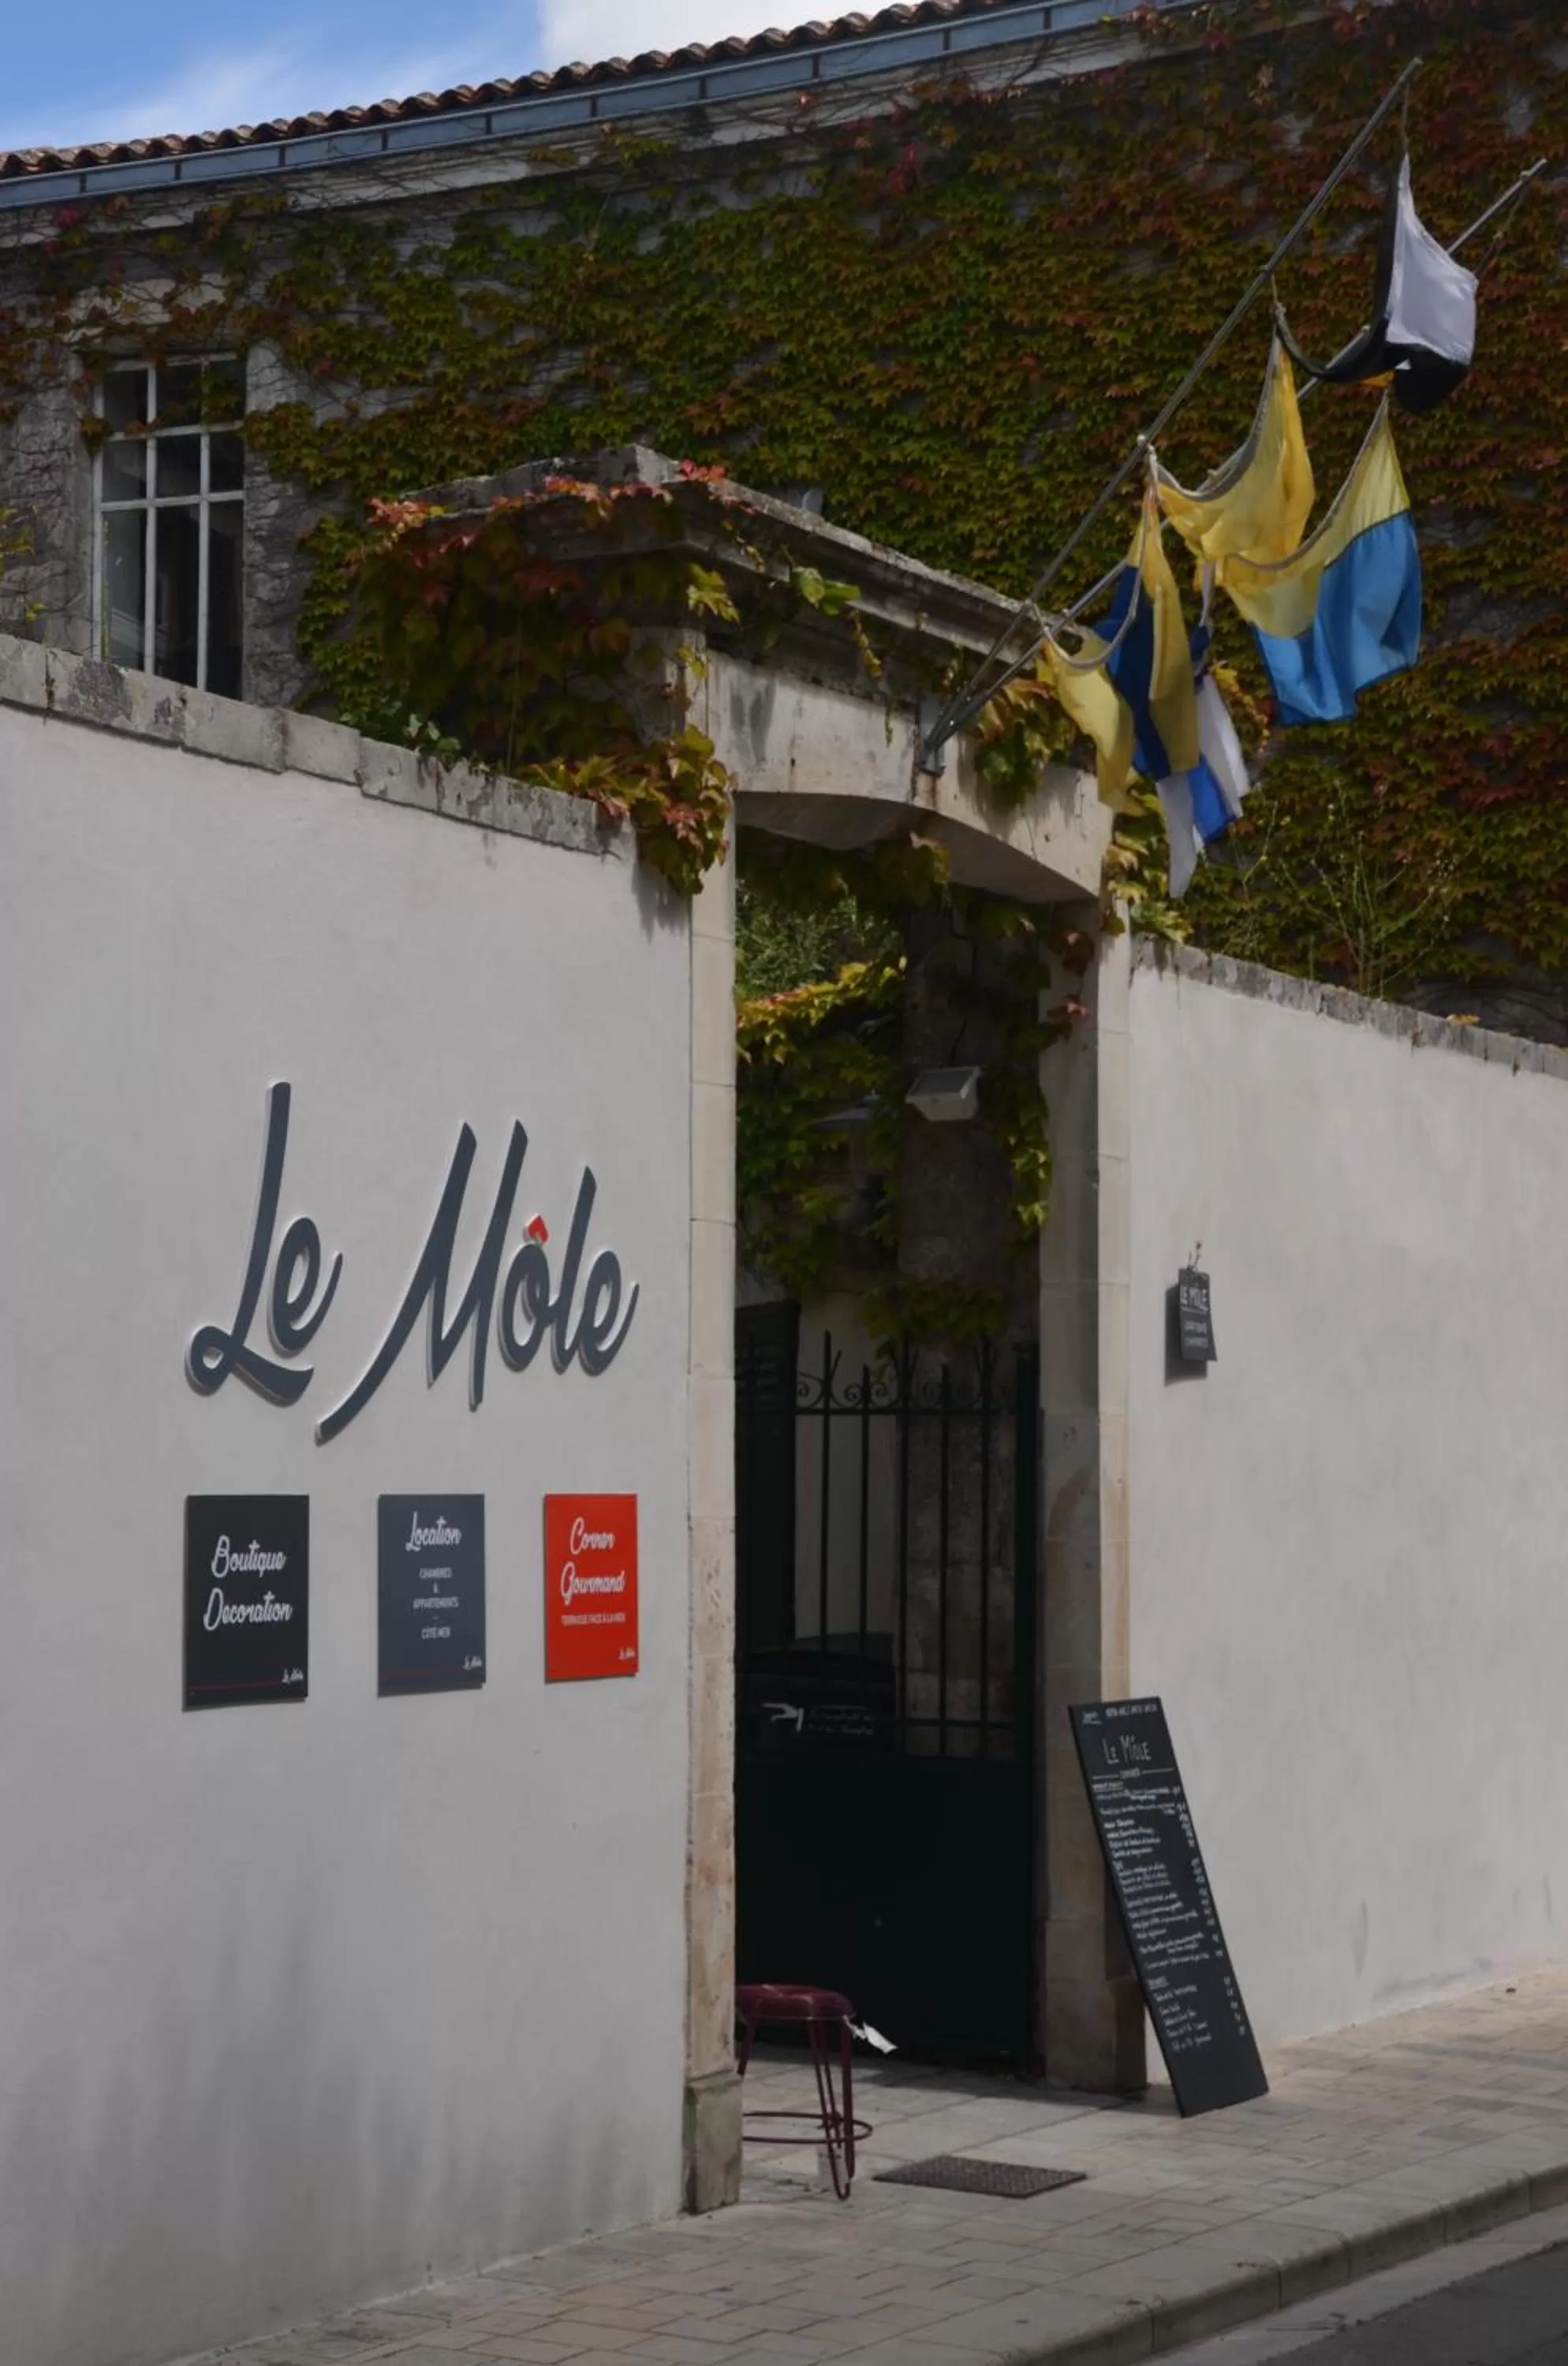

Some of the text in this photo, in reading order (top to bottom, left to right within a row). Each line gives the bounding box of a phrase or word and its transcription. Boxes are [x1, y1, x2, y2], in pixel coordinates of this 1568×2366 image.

[186, 1081, 342, 1406] Le
[405, 1510, 462, 1553] Location
[569, 1517, 615, 1555] Corner
[211, 1534, 286, 1579] Boutique
[560, 1561, 625, 1606] Gourmand
[203, 1587, 293, 1631] Decoration
